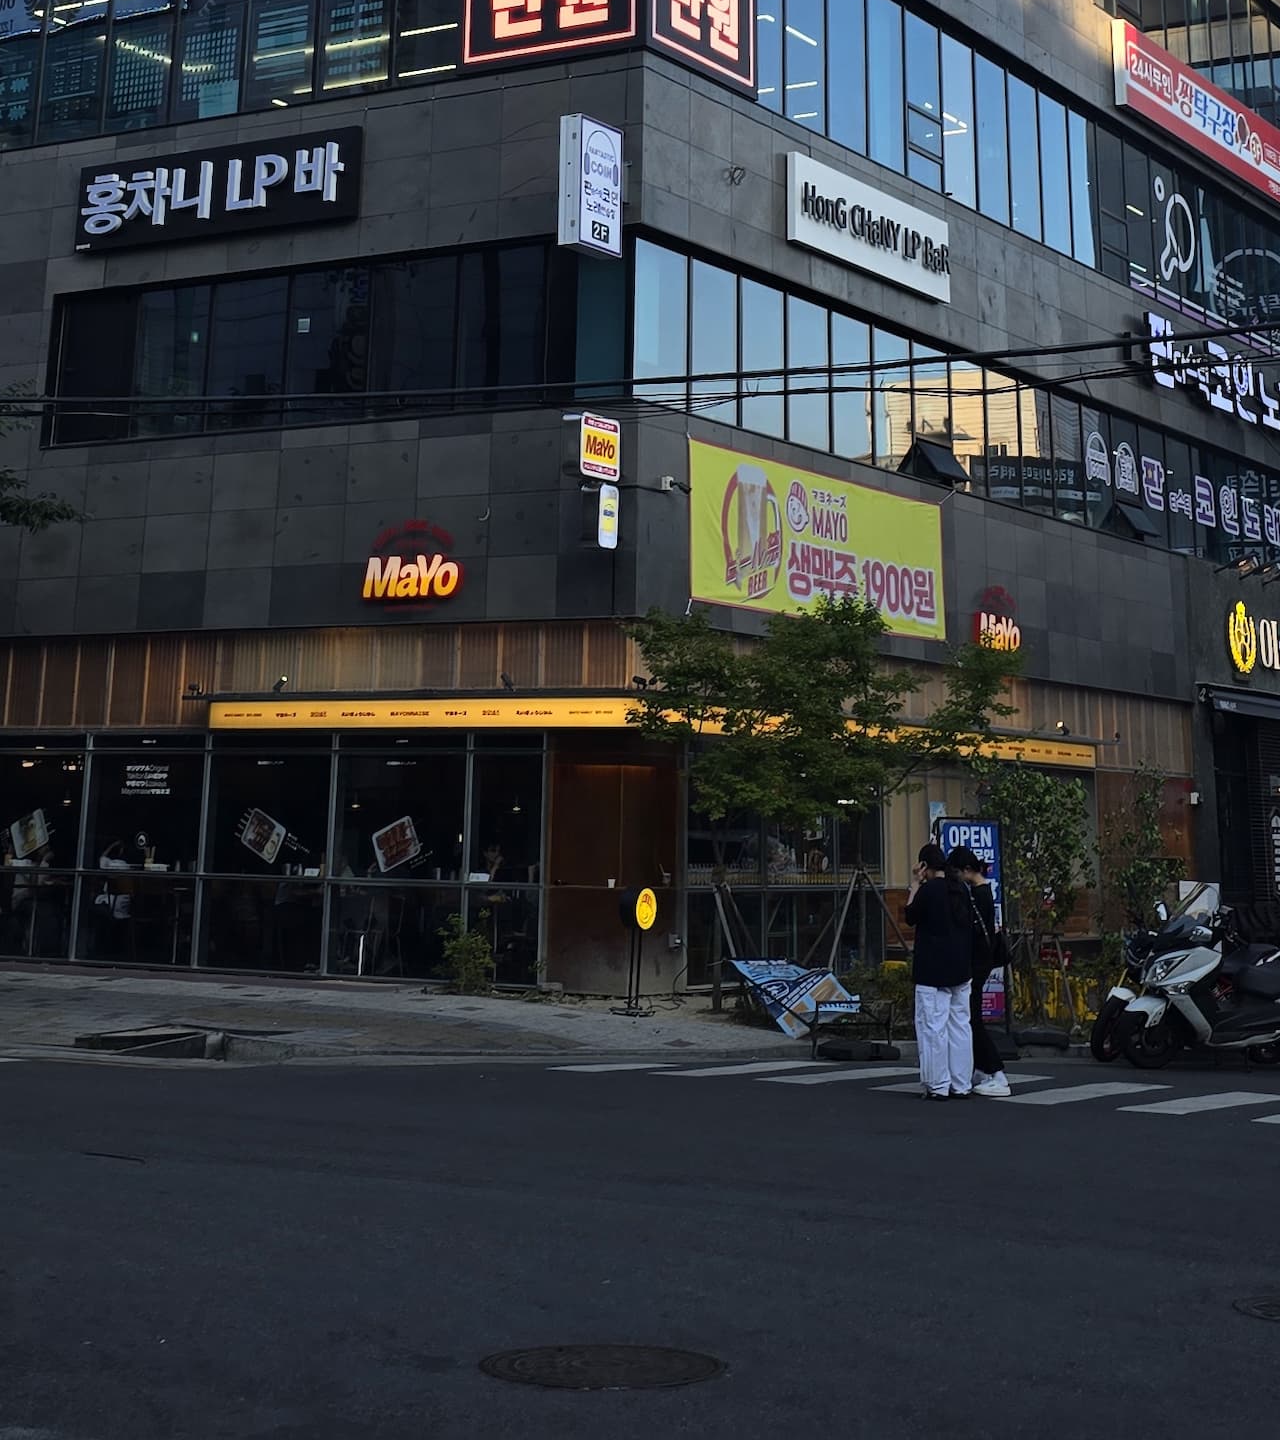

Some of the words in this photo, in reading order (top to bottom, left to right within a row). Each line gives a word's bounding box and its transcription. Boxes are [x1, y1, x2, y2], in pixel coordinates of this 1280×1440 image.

[1130, 53, 1172, 100] 24시무인
[1179, 77, 1236, 147] 짱탁구장
[80, 160, 212, 236] 홍차니
[226, 153, 288, 212] LP
[294, 141, 344, 202] 바
[591, 160, 612, 180] COIN
[593, 220, 608, 243] 2F
[802, 181, 848, 227] HonG
[901, 225, 920, 258] LP
[585, 433, 616, 460] MaYo
[811, 489, 847, 508] マヨネーズ
[812, 506, 849, 544] MAYO
[362, 553, 460, 600] MaYo
[747, 570, 768, 596] BEER
[788, 542, 857, 601] 생맥주
[862, 559, 936, 620] 1900원
[948, 825, 993, 848] OPEN
